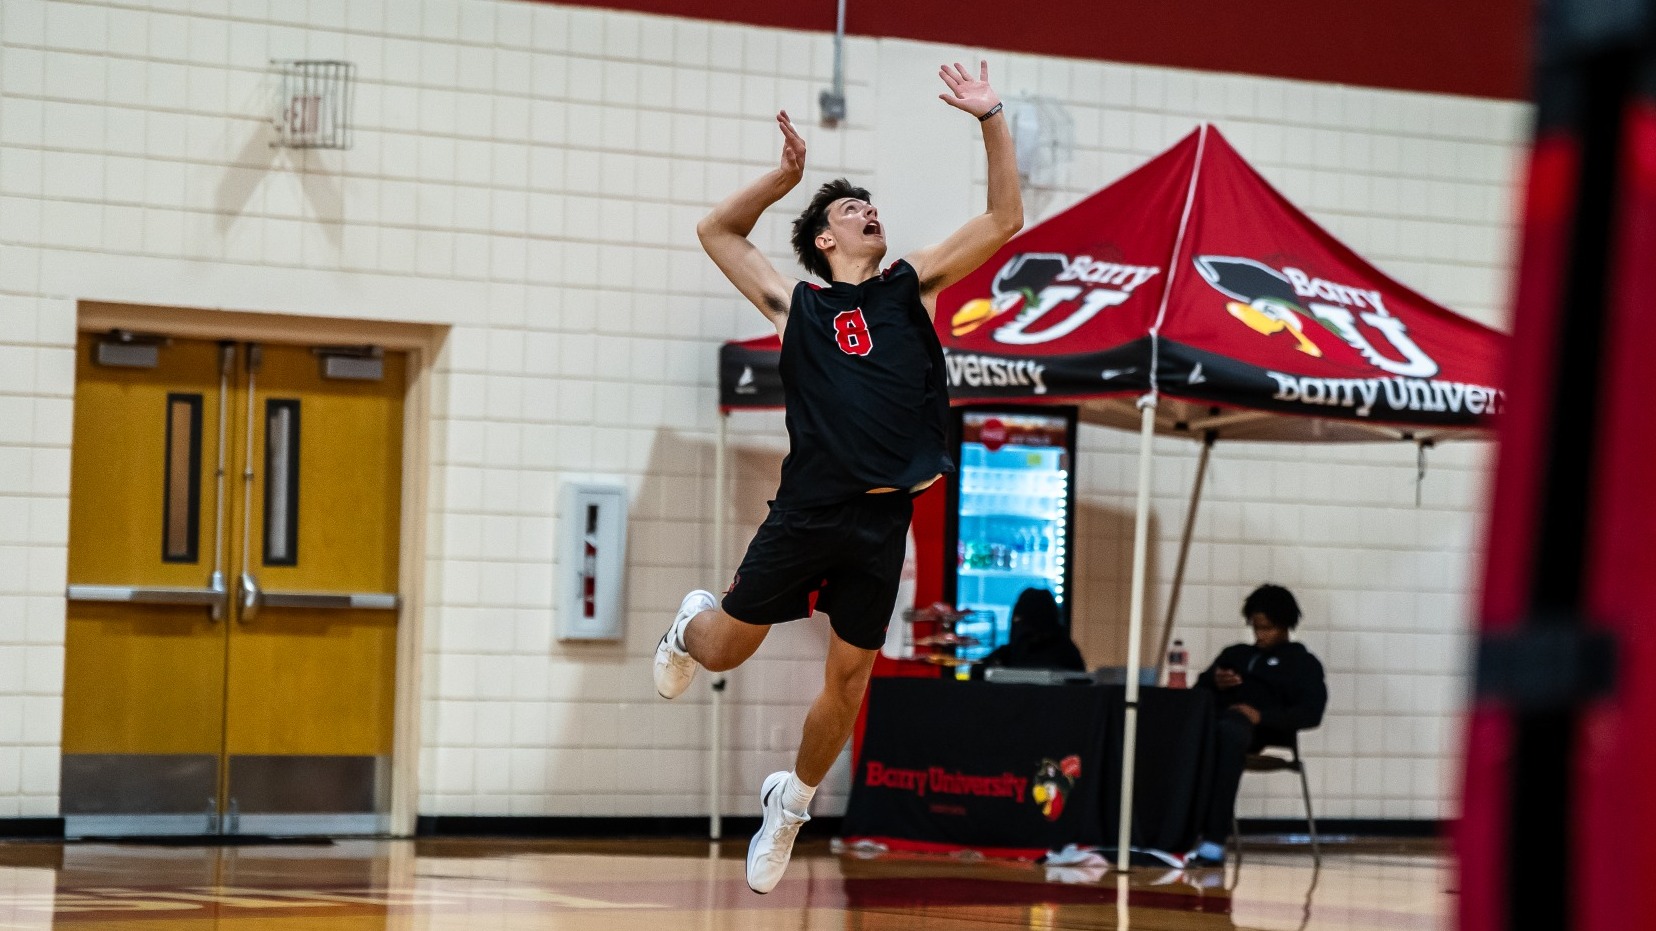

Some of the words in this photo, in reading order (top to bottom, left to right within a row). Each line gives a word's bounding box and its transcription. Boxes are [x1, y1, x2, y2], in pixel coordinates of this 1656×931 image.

[1056, 255, 1161, 292] Barry
[1282, 267, 1389, 317] Barry
[834, 307, 873, 356] 8
[993, 285, 1131, 345] U
[1308, 304, 1439, 378] U
[943, 348, 1047, 394] versity
[1267, 371, 1382, 416] Barry
[1379, 375, 1506, 414] Univer
[866, 761, 927, 796] Barry
[930, 767, 1028, 803] University
